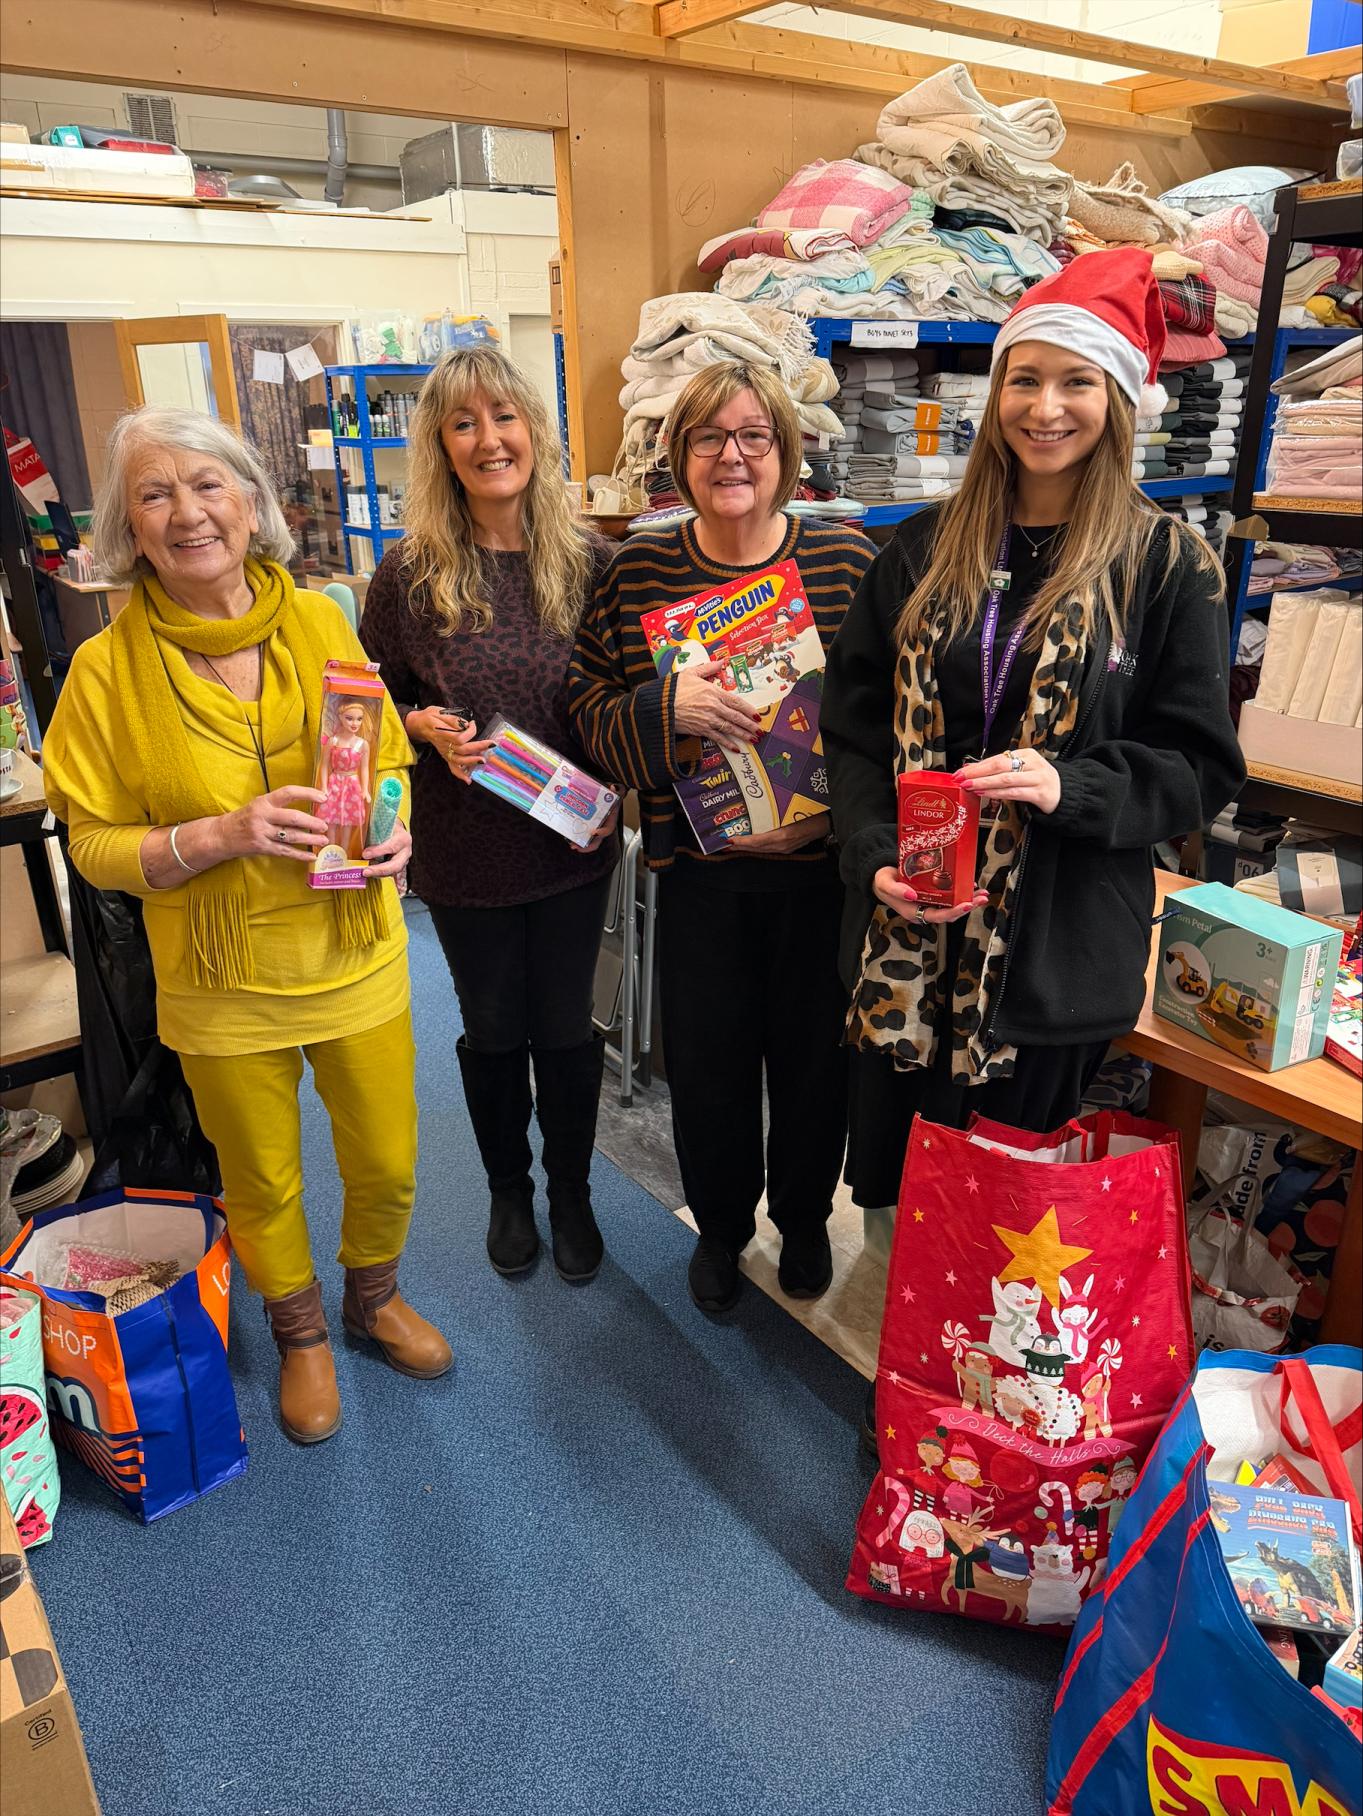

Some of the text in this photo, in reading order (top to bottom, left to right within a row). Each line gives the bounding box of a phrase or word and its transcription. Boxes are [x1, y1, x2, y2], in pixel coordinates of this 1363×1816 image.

[991, 590, 1000, 603] Oak
[697, 579, 775, 640] PENGUIN
[988, 604, 998, 618] Tree
[729, 620, 757, 640] Selection
[755, 614, 769, 627] Box
[982, 620, 995, 649] Housing
[999, 645, 1017, 679] Housing
[983, 651, 991, 699] Association
[993, 680, 1004, 698] Tree
[990, 699, 999, 714] Oak
[741, 752, 764, 799] Cadbury
[702, 790, 740, 809] DAIRY MIL
[912, 797, 939, 808] Lindt
[913, 810, 945, 819] LINDOR
[334, 872, 361, 880] Princess
[1191, 917, 1212, 934] Petal
[1255, 942, 1273, 958] 3+
[1243, 1131, 1267, 1177] from
[43, 1314, 97, 1359] SHOP
[983, 1422, 1091, 1465] Deck the Halls
[24, 1708, 52, 1726] Certified
